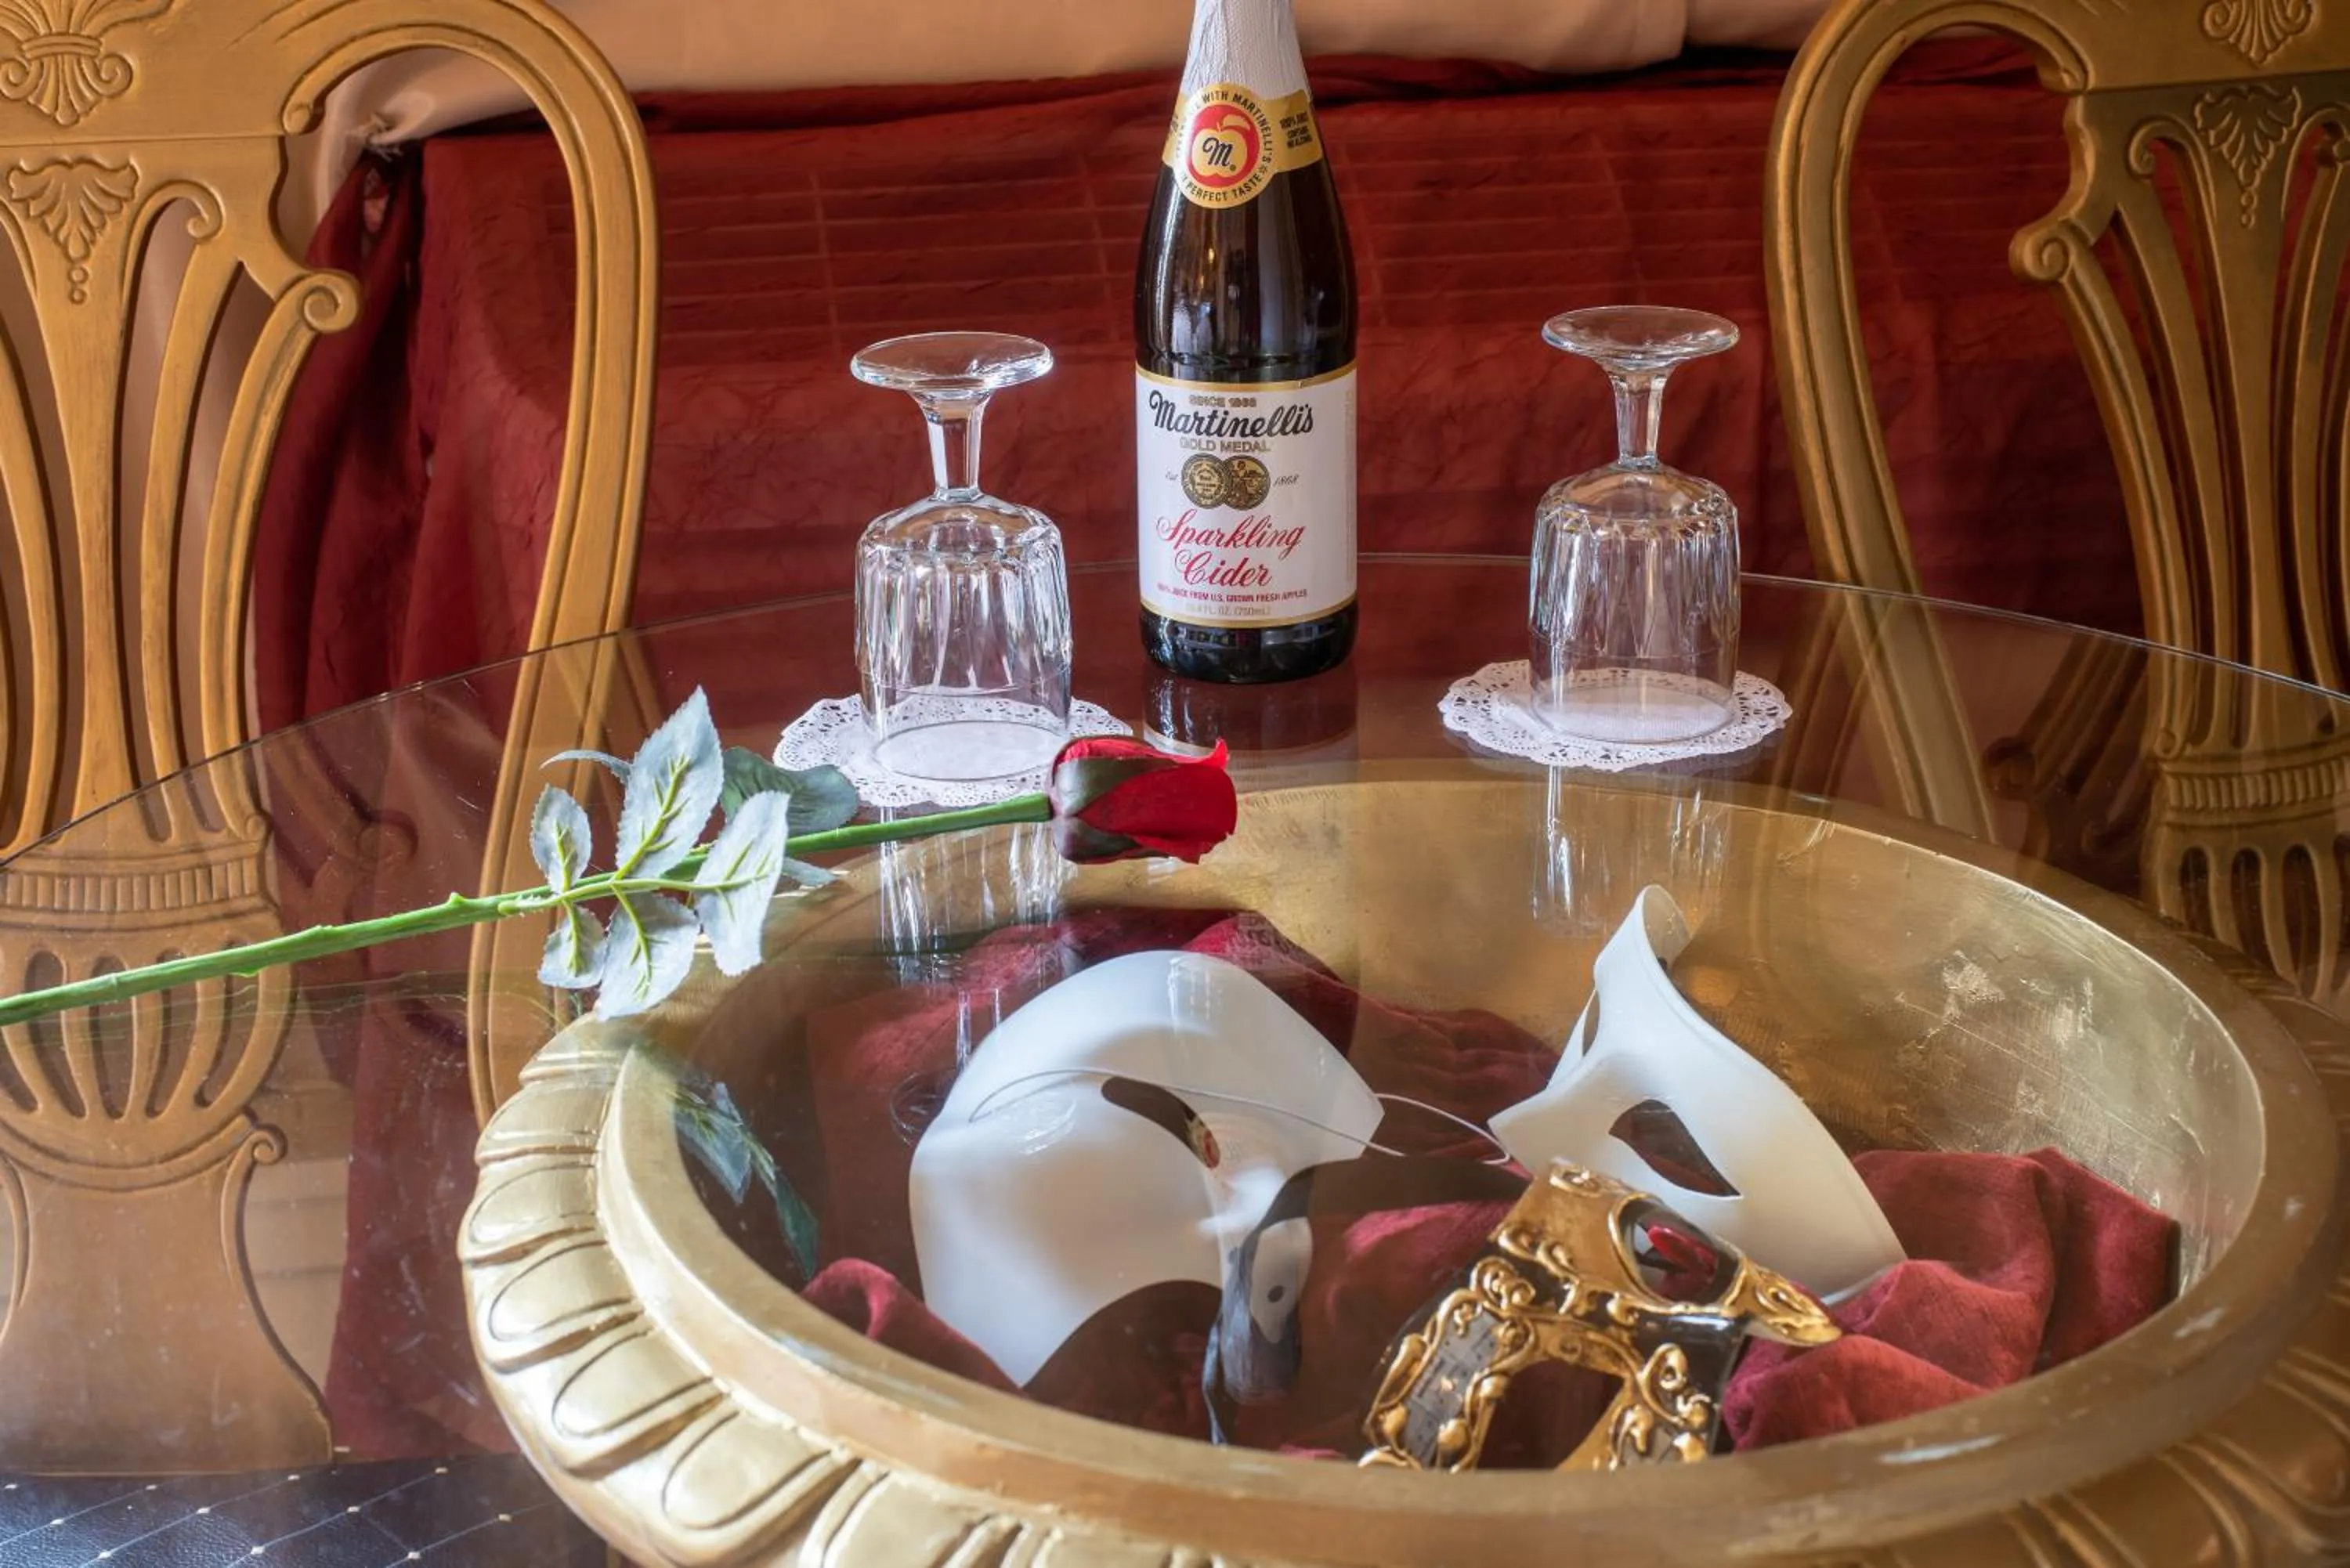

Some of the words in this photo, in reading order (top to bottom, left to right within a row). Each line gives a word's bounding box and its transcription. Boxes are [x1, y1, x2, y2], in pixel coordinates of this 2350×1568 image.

[1202, 90, 1228, 104] WITH
[1232, 93, 1274, 163] MARTINELLI'S
[1185, 179, 1228, 201] PERFECT
[1231, 175, 1263, 198] TASTE
[1149, 389, 1314, 438] Martinelli's
[1180, 436, 1215, 452] GOLD
[1220, 440, 1271, 453] MEDAL
[1156, 509, 1306, 560] Sparkling
[1174, 549, 1273, 587] Cider
[1256, 592, 1281, 602] FRESH
